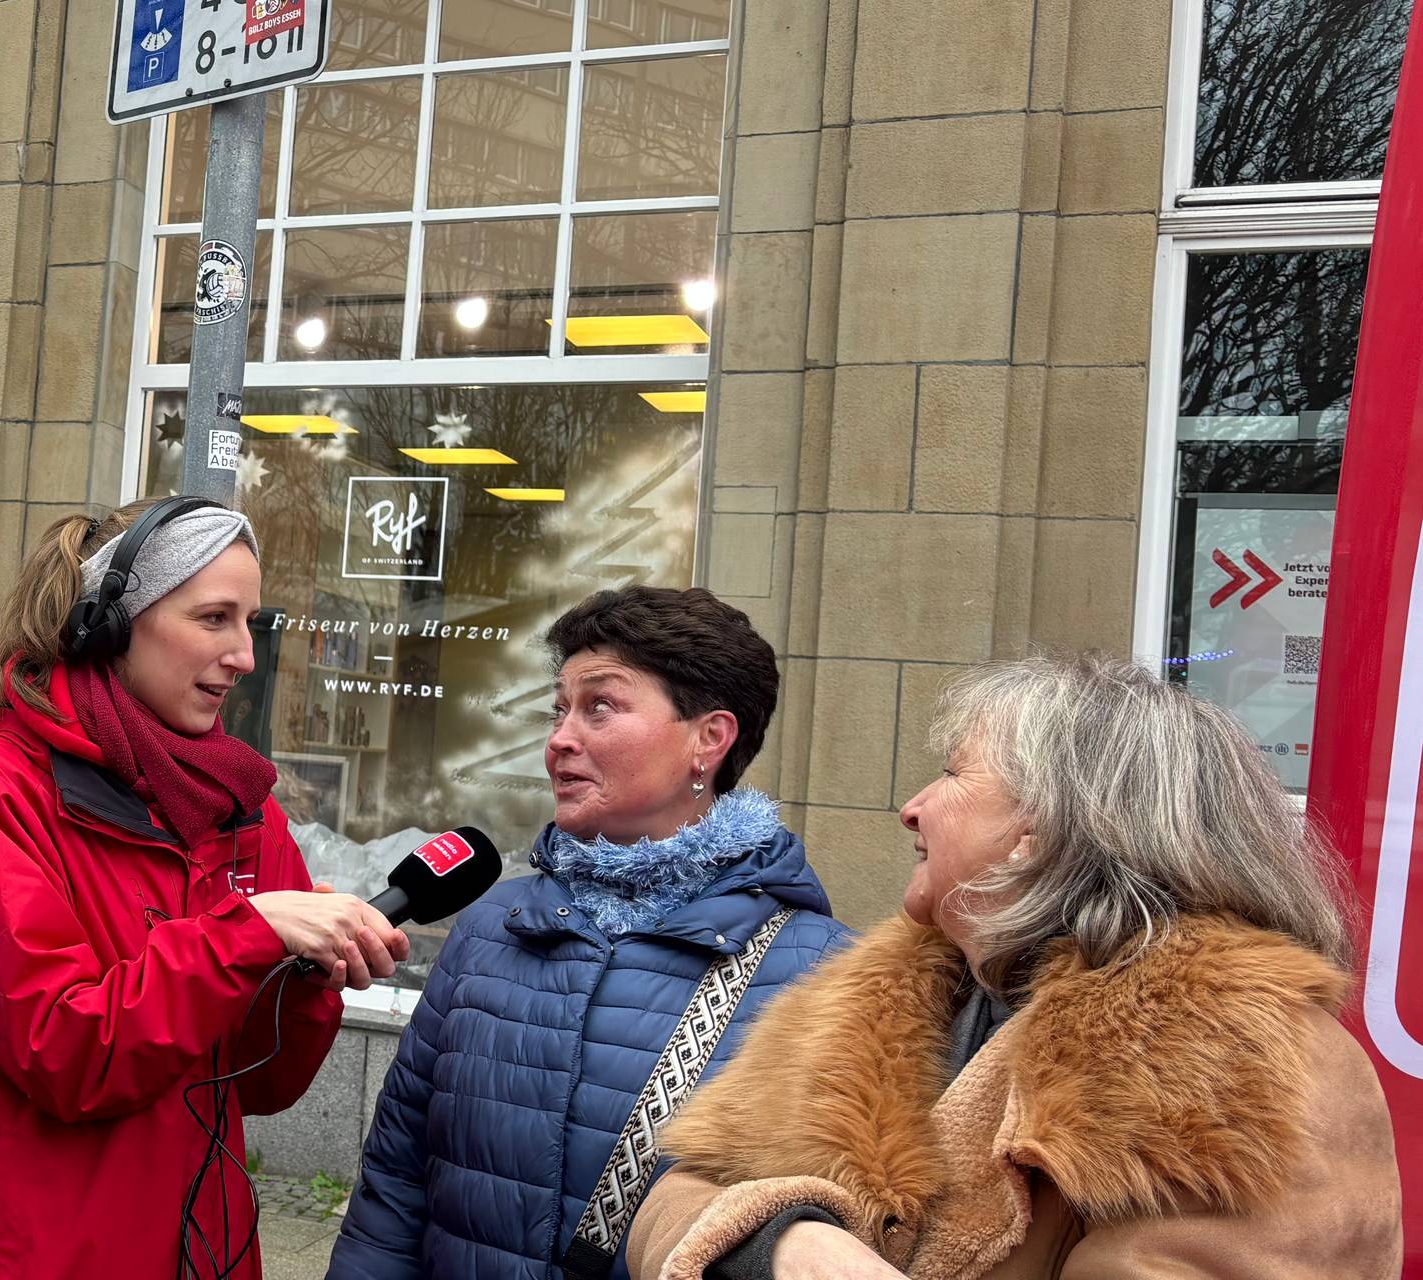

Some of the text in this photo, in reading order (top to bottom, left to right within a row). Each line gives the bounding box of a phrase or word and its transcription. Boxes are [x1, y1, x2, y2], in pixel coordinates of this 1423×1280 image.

[248, 8, 302, 36] BOLZ BOYS ESSEN
[148, 57, 159, 78] P
[365, 492, 426, 555] Ryf
[361, 557, 424, 566] OF SWITZERLAND
[1283, 562, 1330, 573] Jetzt vo
[1295, 575, 1329, 587] Exper
[1288, 588, 1328, 598] berate
[270, 613, 511, 641] Friseur von Herzen
[324, 679, 444, 699] WWW.RYF.DE
[440, 838, 458, 855] radio
